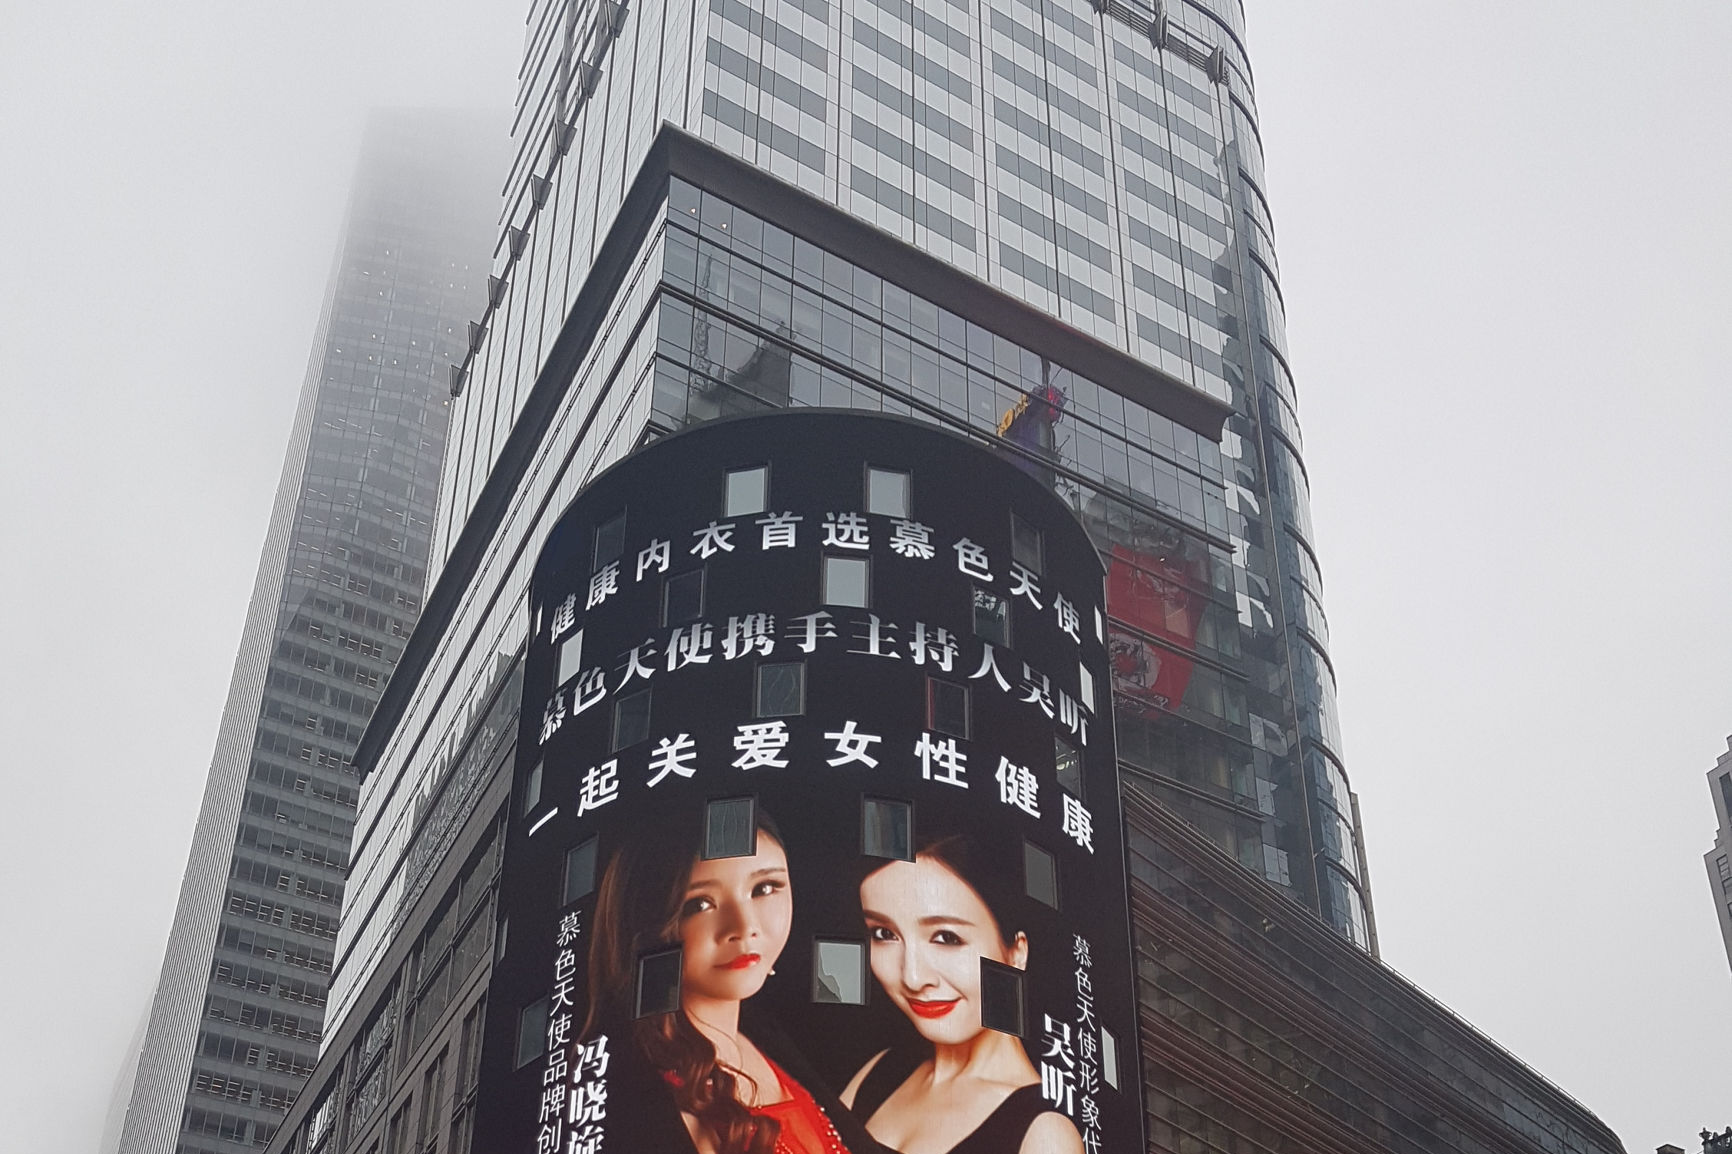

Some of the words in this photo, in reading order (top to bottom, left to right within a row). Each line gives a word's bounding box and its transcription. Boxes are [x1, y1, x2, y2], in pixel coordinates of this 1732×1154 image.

[550, 511, 1081, 646] 健康内衣首选慕色天使
[539, 610, 1088, 747] 慕色天使携手主持人吴昕
[528, 720, 1096, 855] 一起关爱女性健康
[1040, 1012, 1077, 1117] 吴昕
